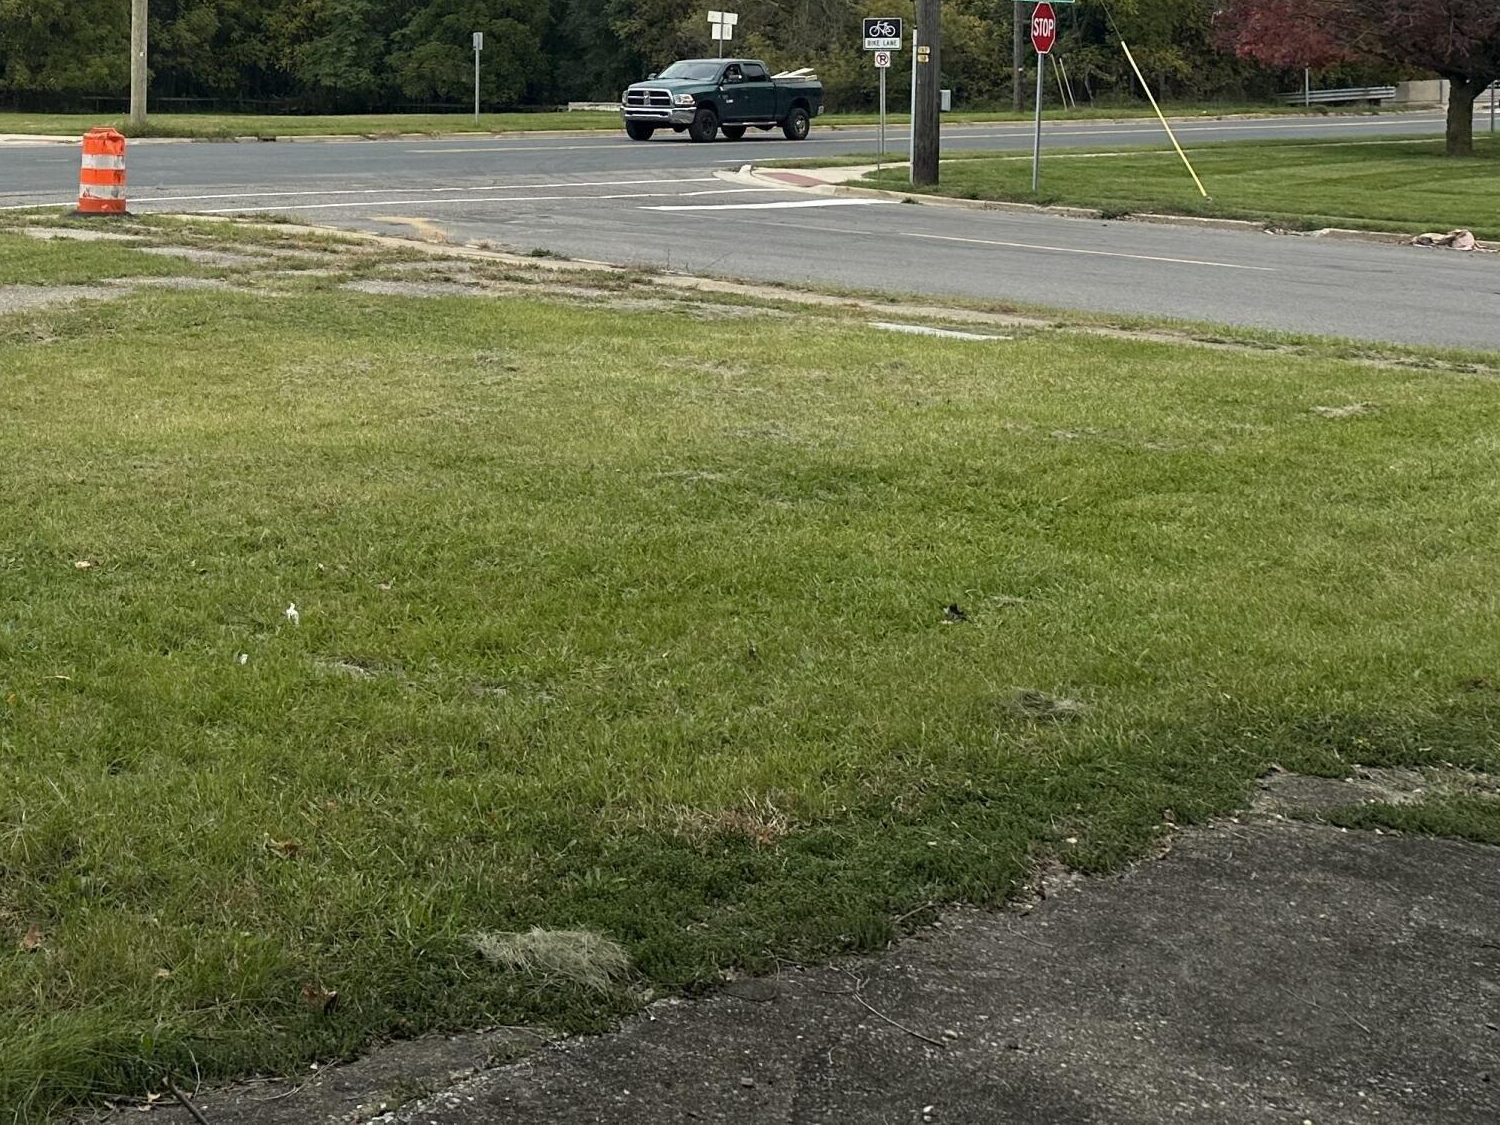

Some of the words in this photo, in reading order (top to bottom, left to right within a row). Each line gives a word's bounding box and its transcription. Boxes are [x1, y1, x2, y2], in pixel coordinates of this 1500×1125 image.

[1033, 17, 1054, 37] STOP
[867, 39, 881, 47] BIKE
[883, 39, 898, 47] LANE
